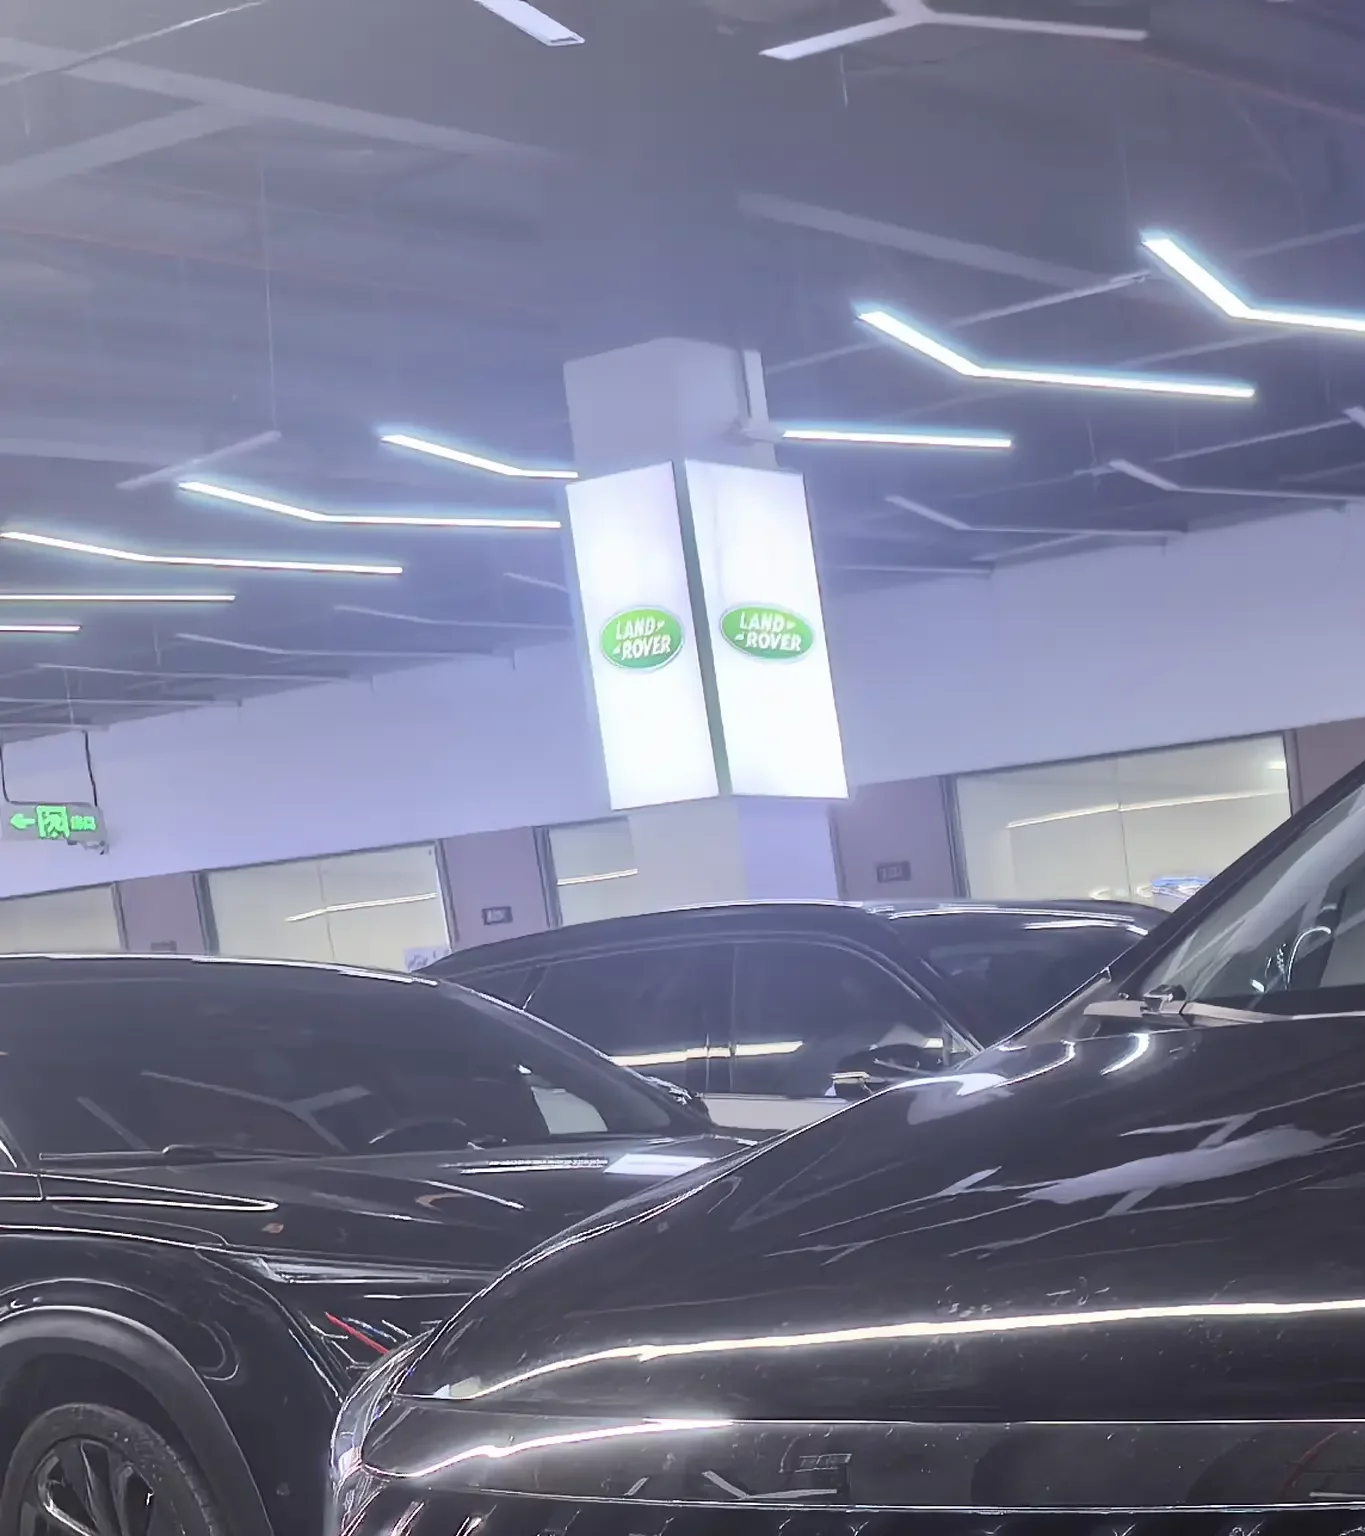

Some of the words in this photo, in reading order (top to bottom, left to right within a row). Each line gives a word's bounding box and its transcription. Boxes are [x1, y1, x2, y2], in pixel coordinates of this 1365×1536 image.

[615, 616, 653, 641] LAND
[740, 611, 785, 632] LAND
[621, 634, 672, 661] ROVER
[744, 630, 803, 652] ROVER
